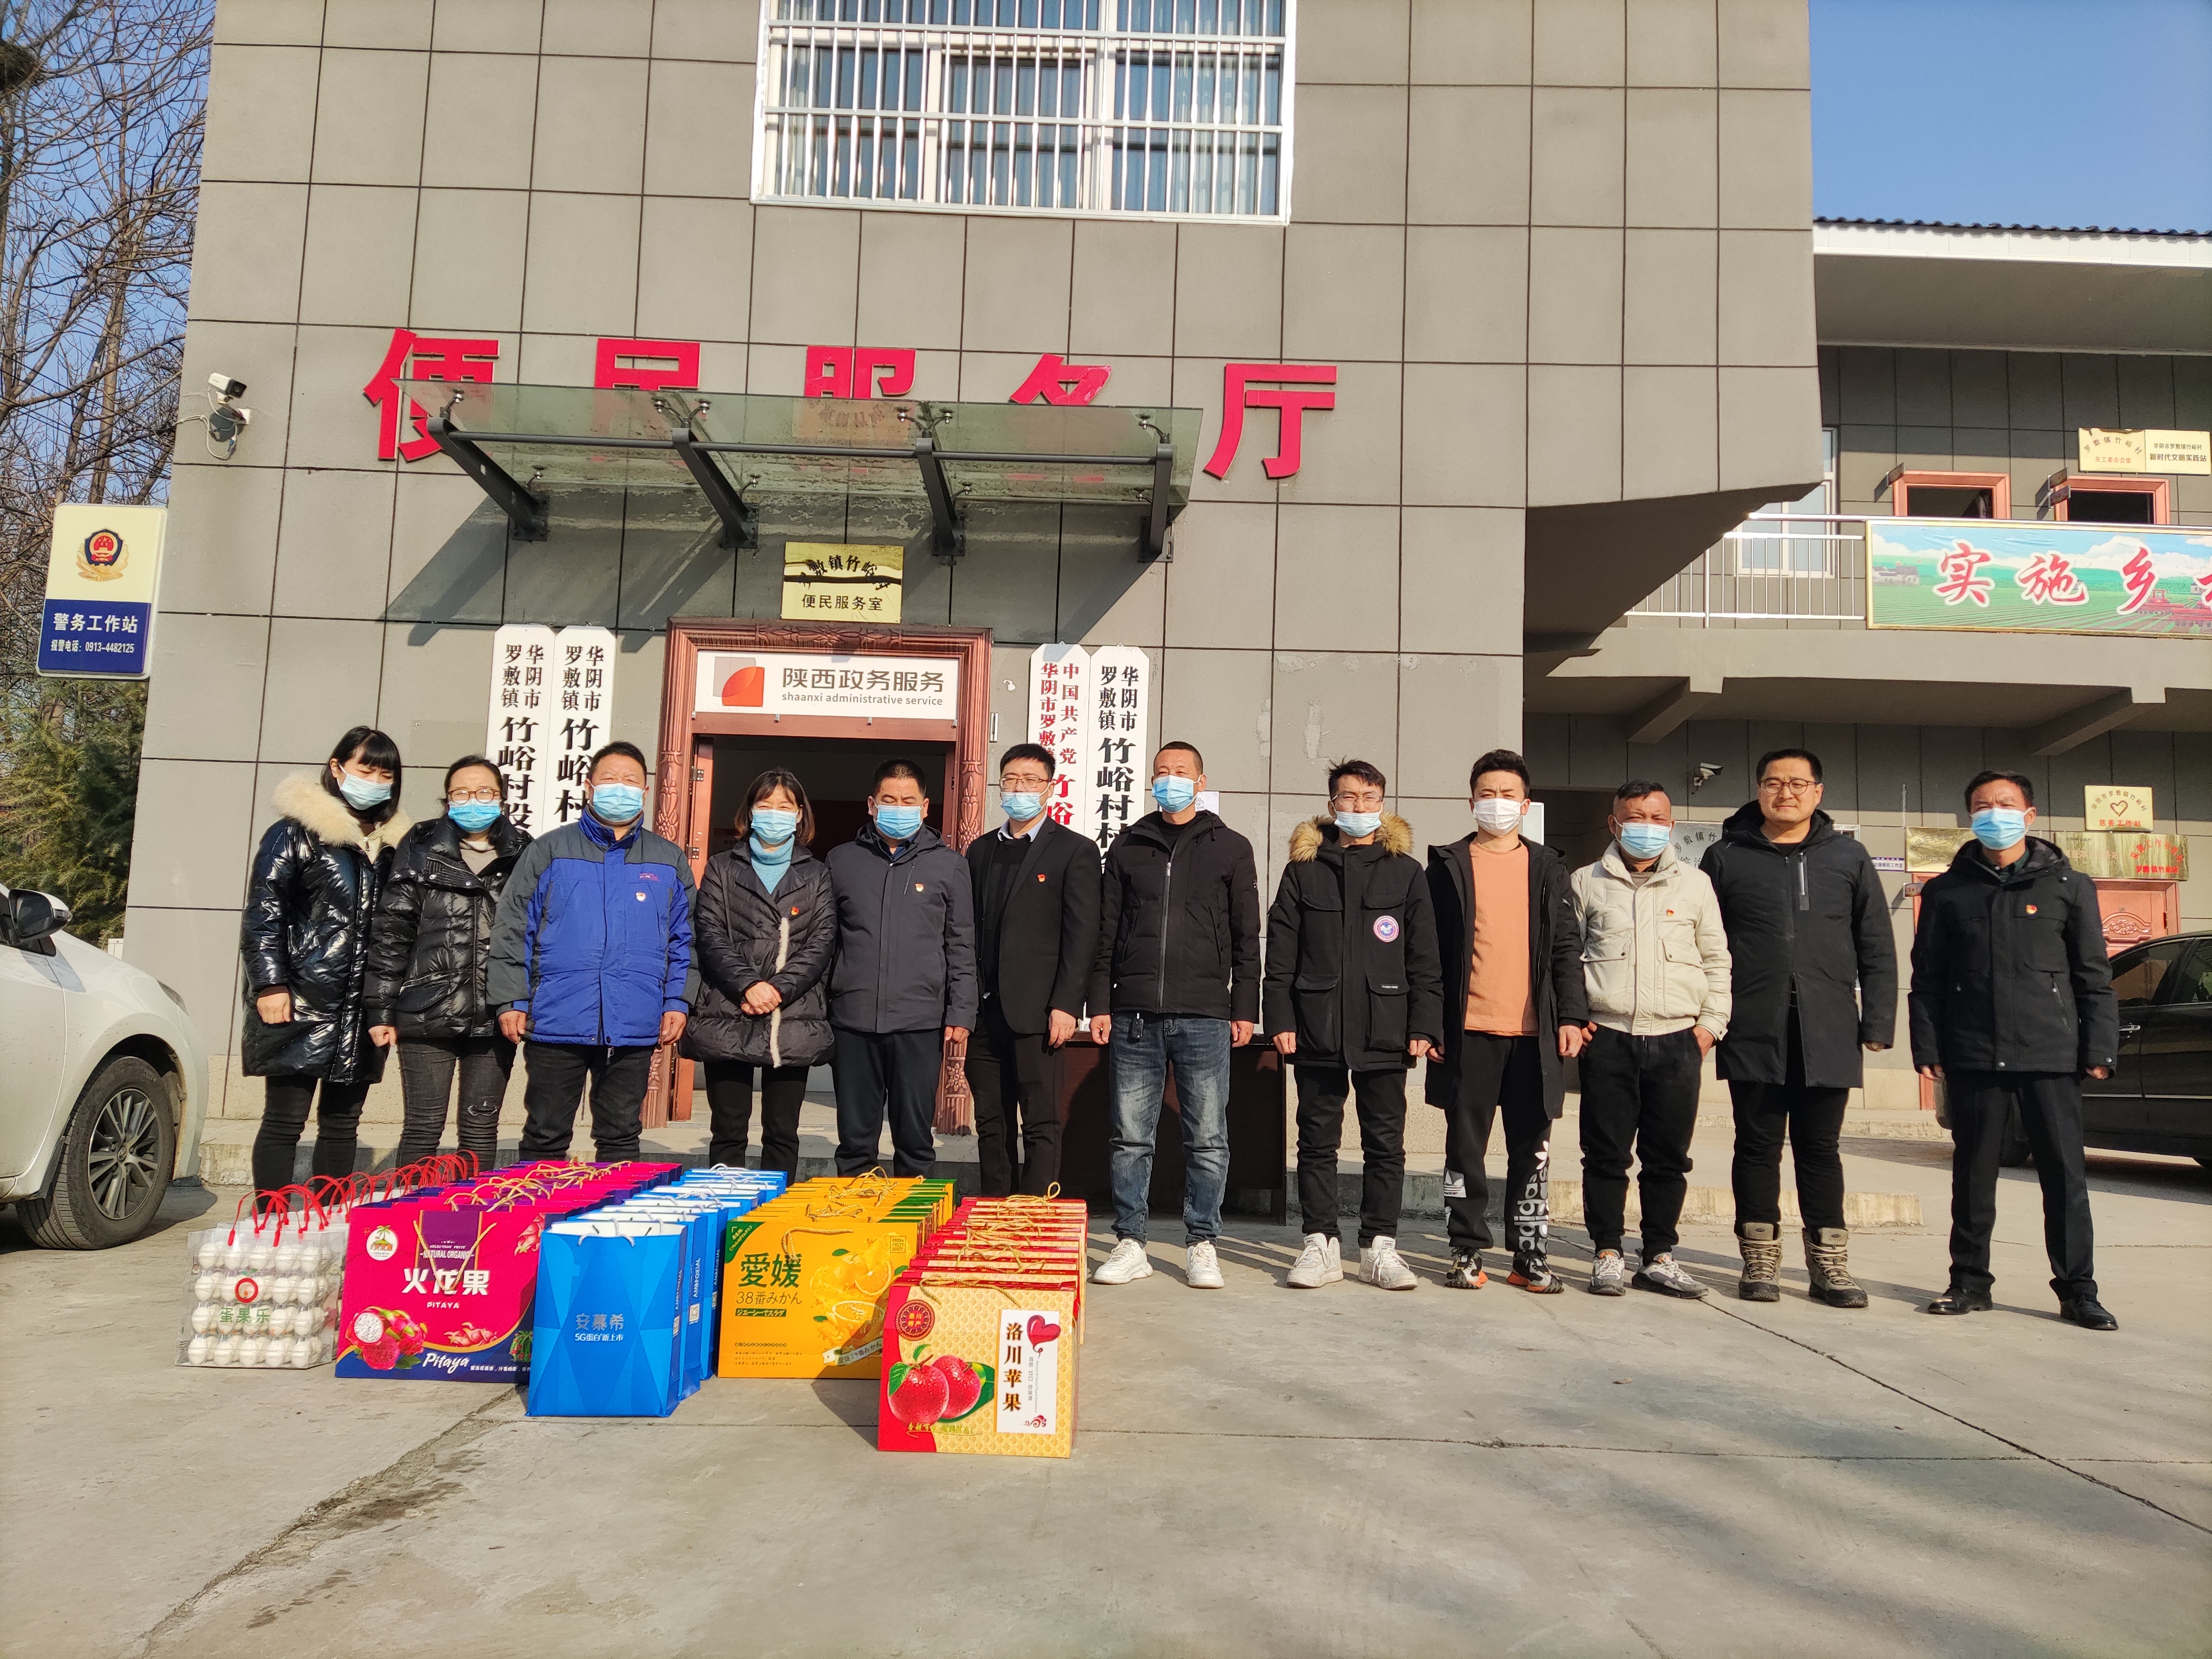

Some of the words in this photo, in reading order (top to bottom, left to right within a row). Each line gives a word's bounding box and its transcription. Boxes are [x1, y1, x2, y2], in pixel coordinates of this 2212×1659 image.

[2150, 453, 2206, 462] 新时代文明实践站
[802, 593, 883, 611] 便民服务室
[53, 612, 138, 633] 警务工作站
[500, 644, 522, 708] 罗敷镇
[523, 644, 544, 709] 华阴市
[561, 645, 583, 711] 罗敷镇
[583, 645, 604, 712] 华阴市
[782, 667, 944, 692] 陕西政务服务
[781, 692, 823, 702] shaanxi
[826, 693, 903, 705] administrative
[905, 696, 943, 706] service
[1098, 665, 1117, 731] 罗敷镇
[1120, 665, 1139, 732] 华阴市
[1059, 663, 1079, 765] 中国共产党
[401, 1267, 491, 1296] 火龙果
[736, 1291, 802, 1306] 38番みかん
[219, 1307, 271, 1323] 蛋果乐
[575, 1312, 625, 1332] 安慕希
[422, 1353, 470, 1374] Pitaya
[1003, 1322, 1024, 1412] 洛川苹果
